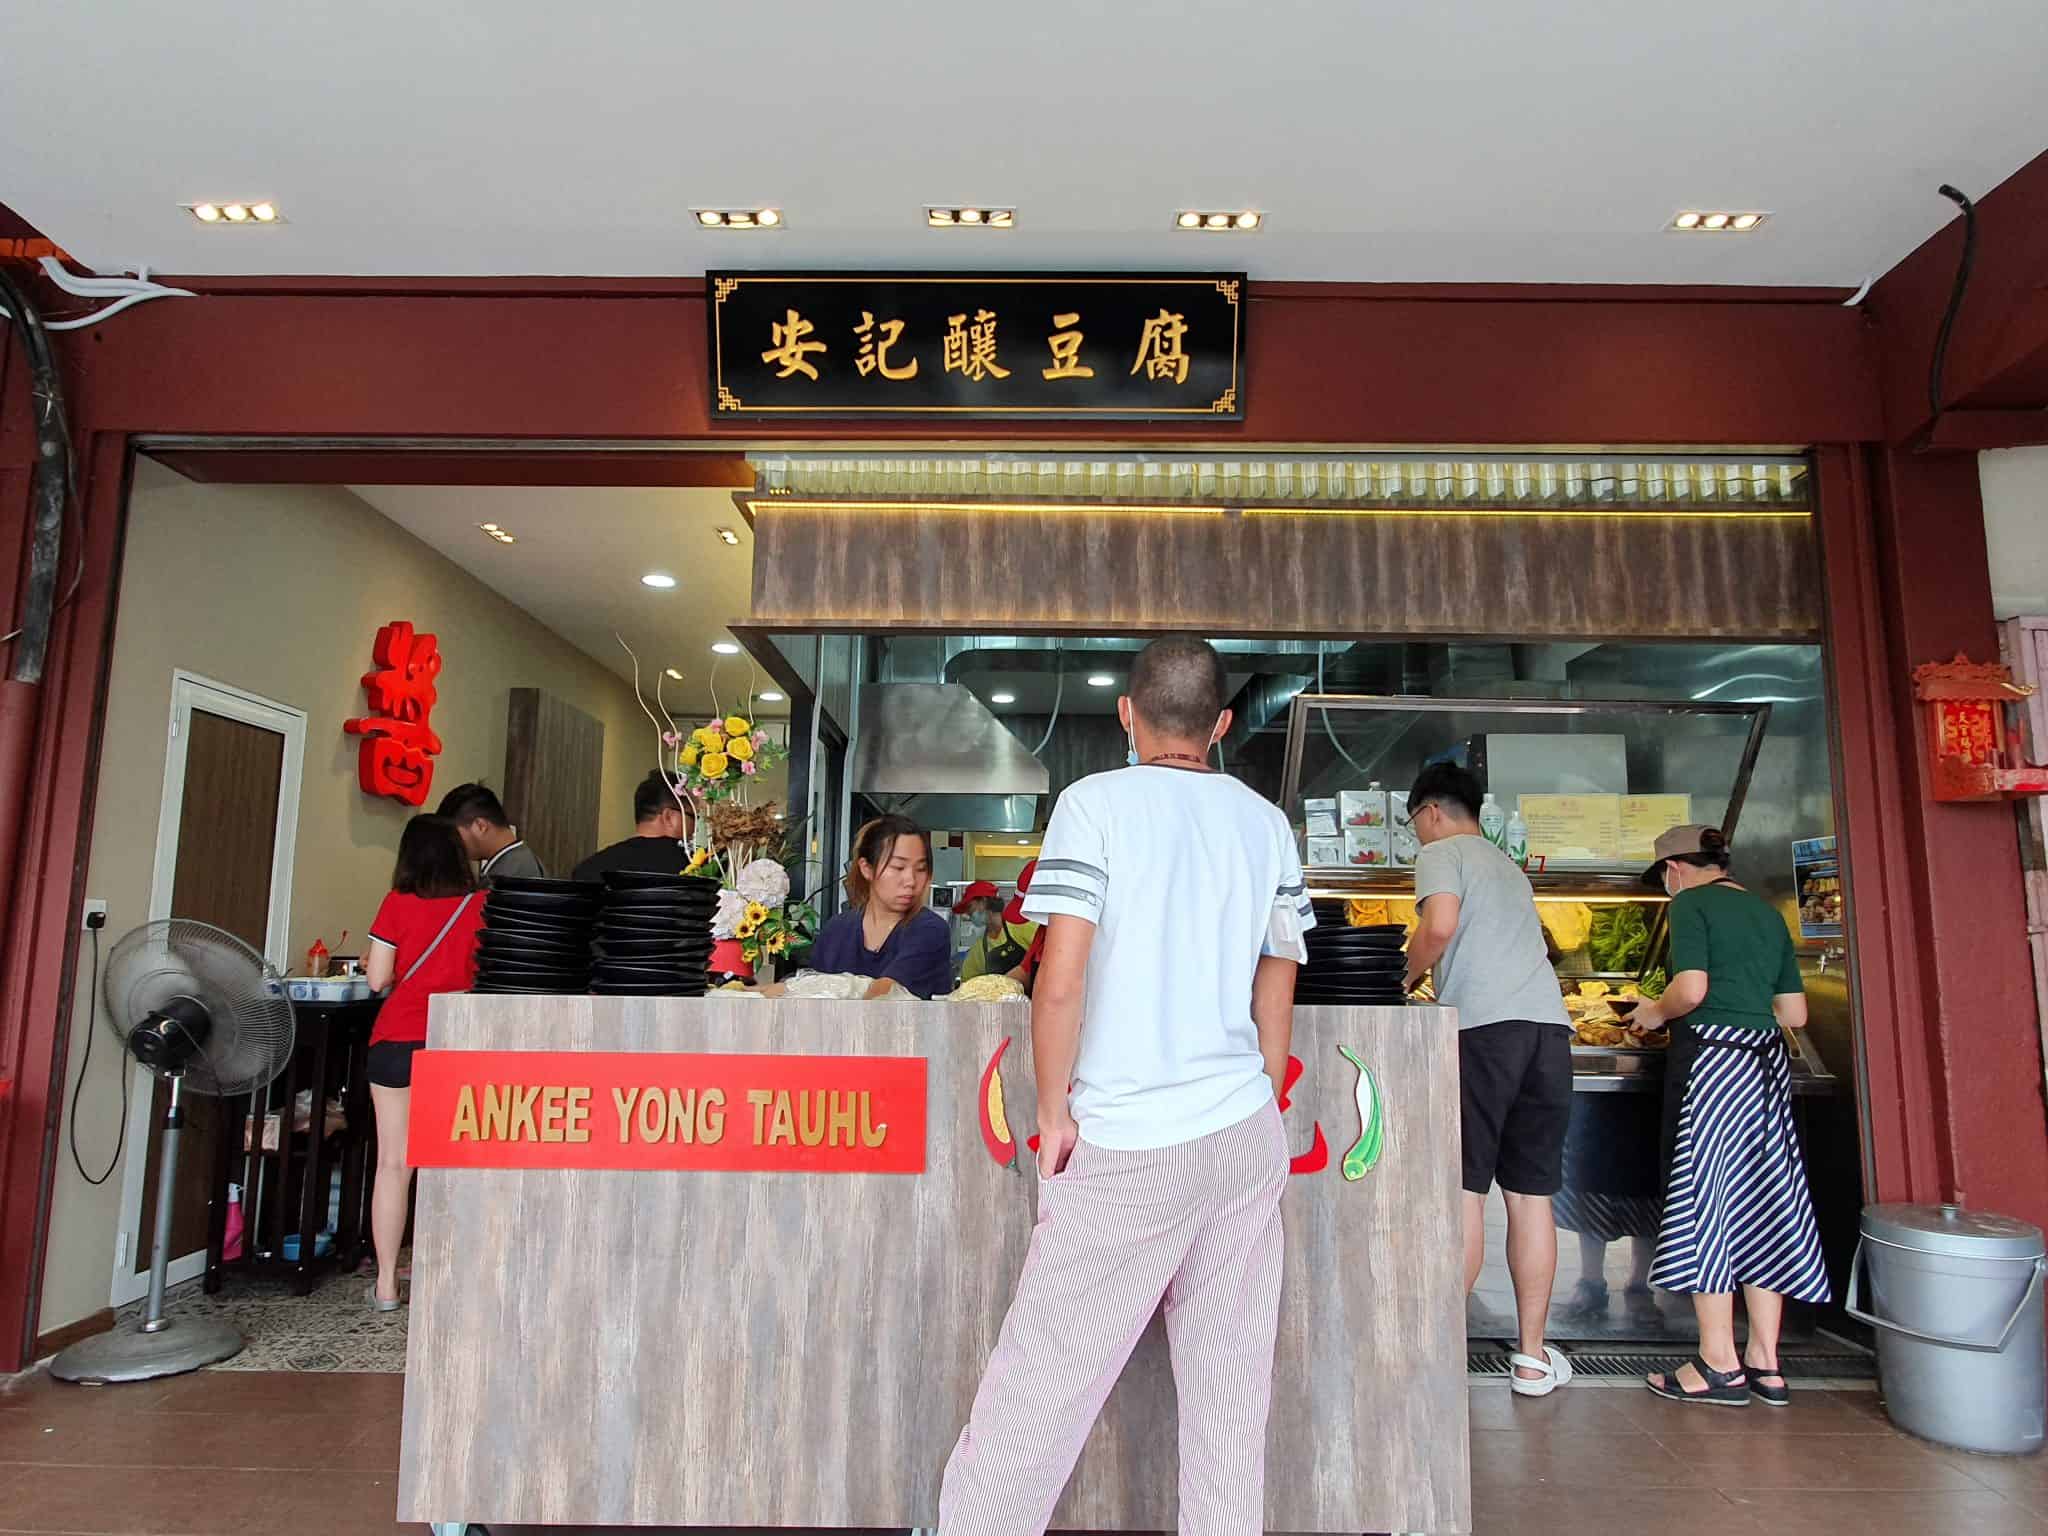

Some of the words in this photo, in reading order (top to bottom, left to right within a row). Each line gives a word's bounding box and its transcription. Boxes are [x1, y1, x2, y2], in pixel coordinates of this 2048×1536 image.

[761, 309, 1191, 386] 安記釀豆腐
[450, 1084, 592, 1143] ANKEE
[611, 1087, 726, 1145] YONG
